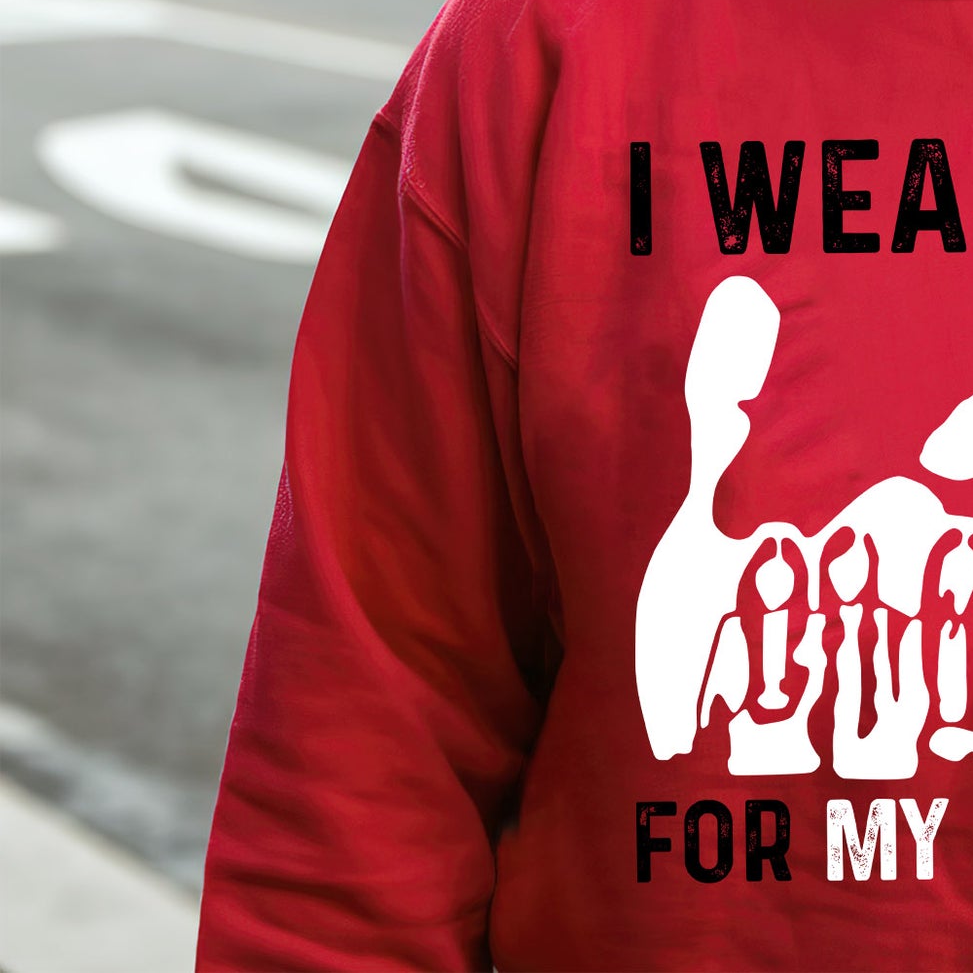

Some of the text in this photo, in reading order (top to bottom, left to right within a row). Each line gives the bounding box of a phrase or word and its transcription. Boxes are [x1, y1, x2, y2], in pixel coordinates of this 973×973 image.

[630, 141, 652, 255] I
[636, 798, 792, 883] FOR
[826, 797, 950, 882] MY
